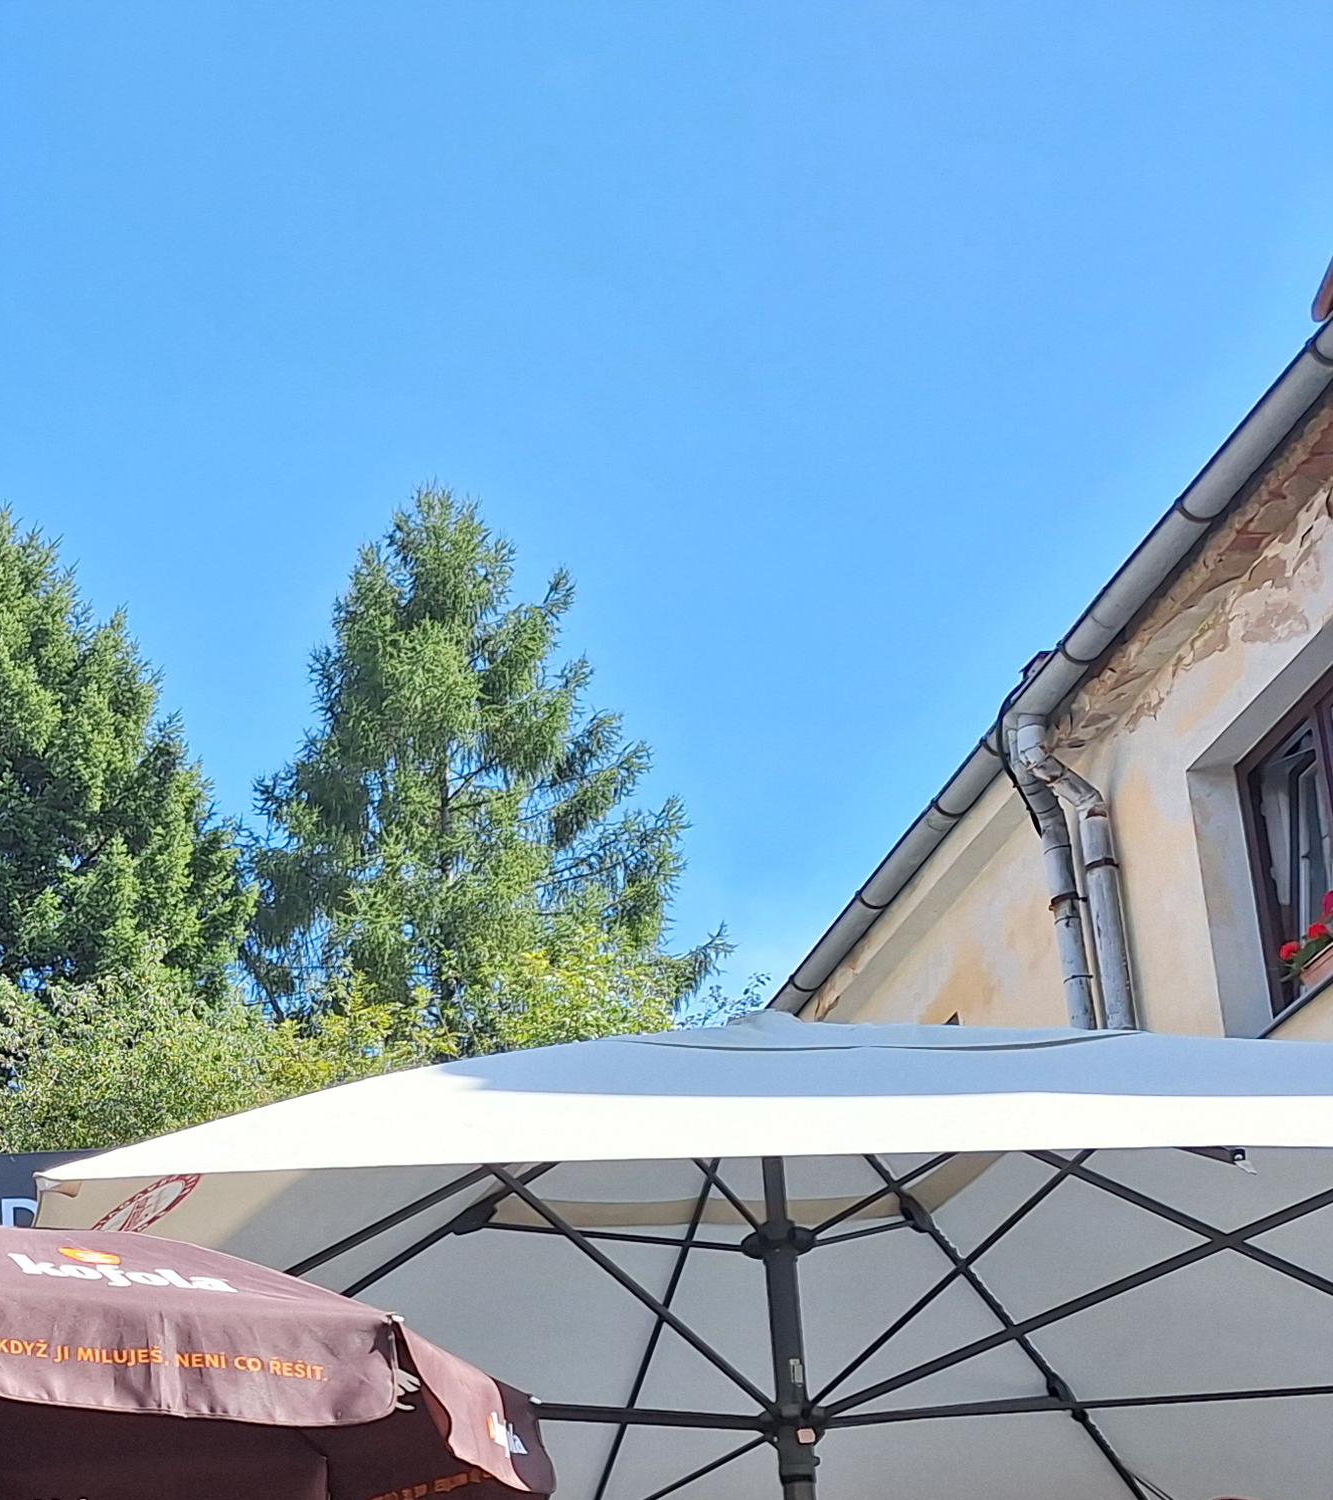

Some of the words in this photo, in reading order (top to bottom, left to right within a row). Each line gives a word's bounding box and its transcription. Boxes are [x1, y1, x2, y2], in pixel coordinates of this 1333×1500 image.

[8, 1252, 237, 1293] kofola
[53, 1345, 69, 1363] JI
[175, 1350, 227, 1369] NENÍ
[234, 1355, 263, 1372] CO
